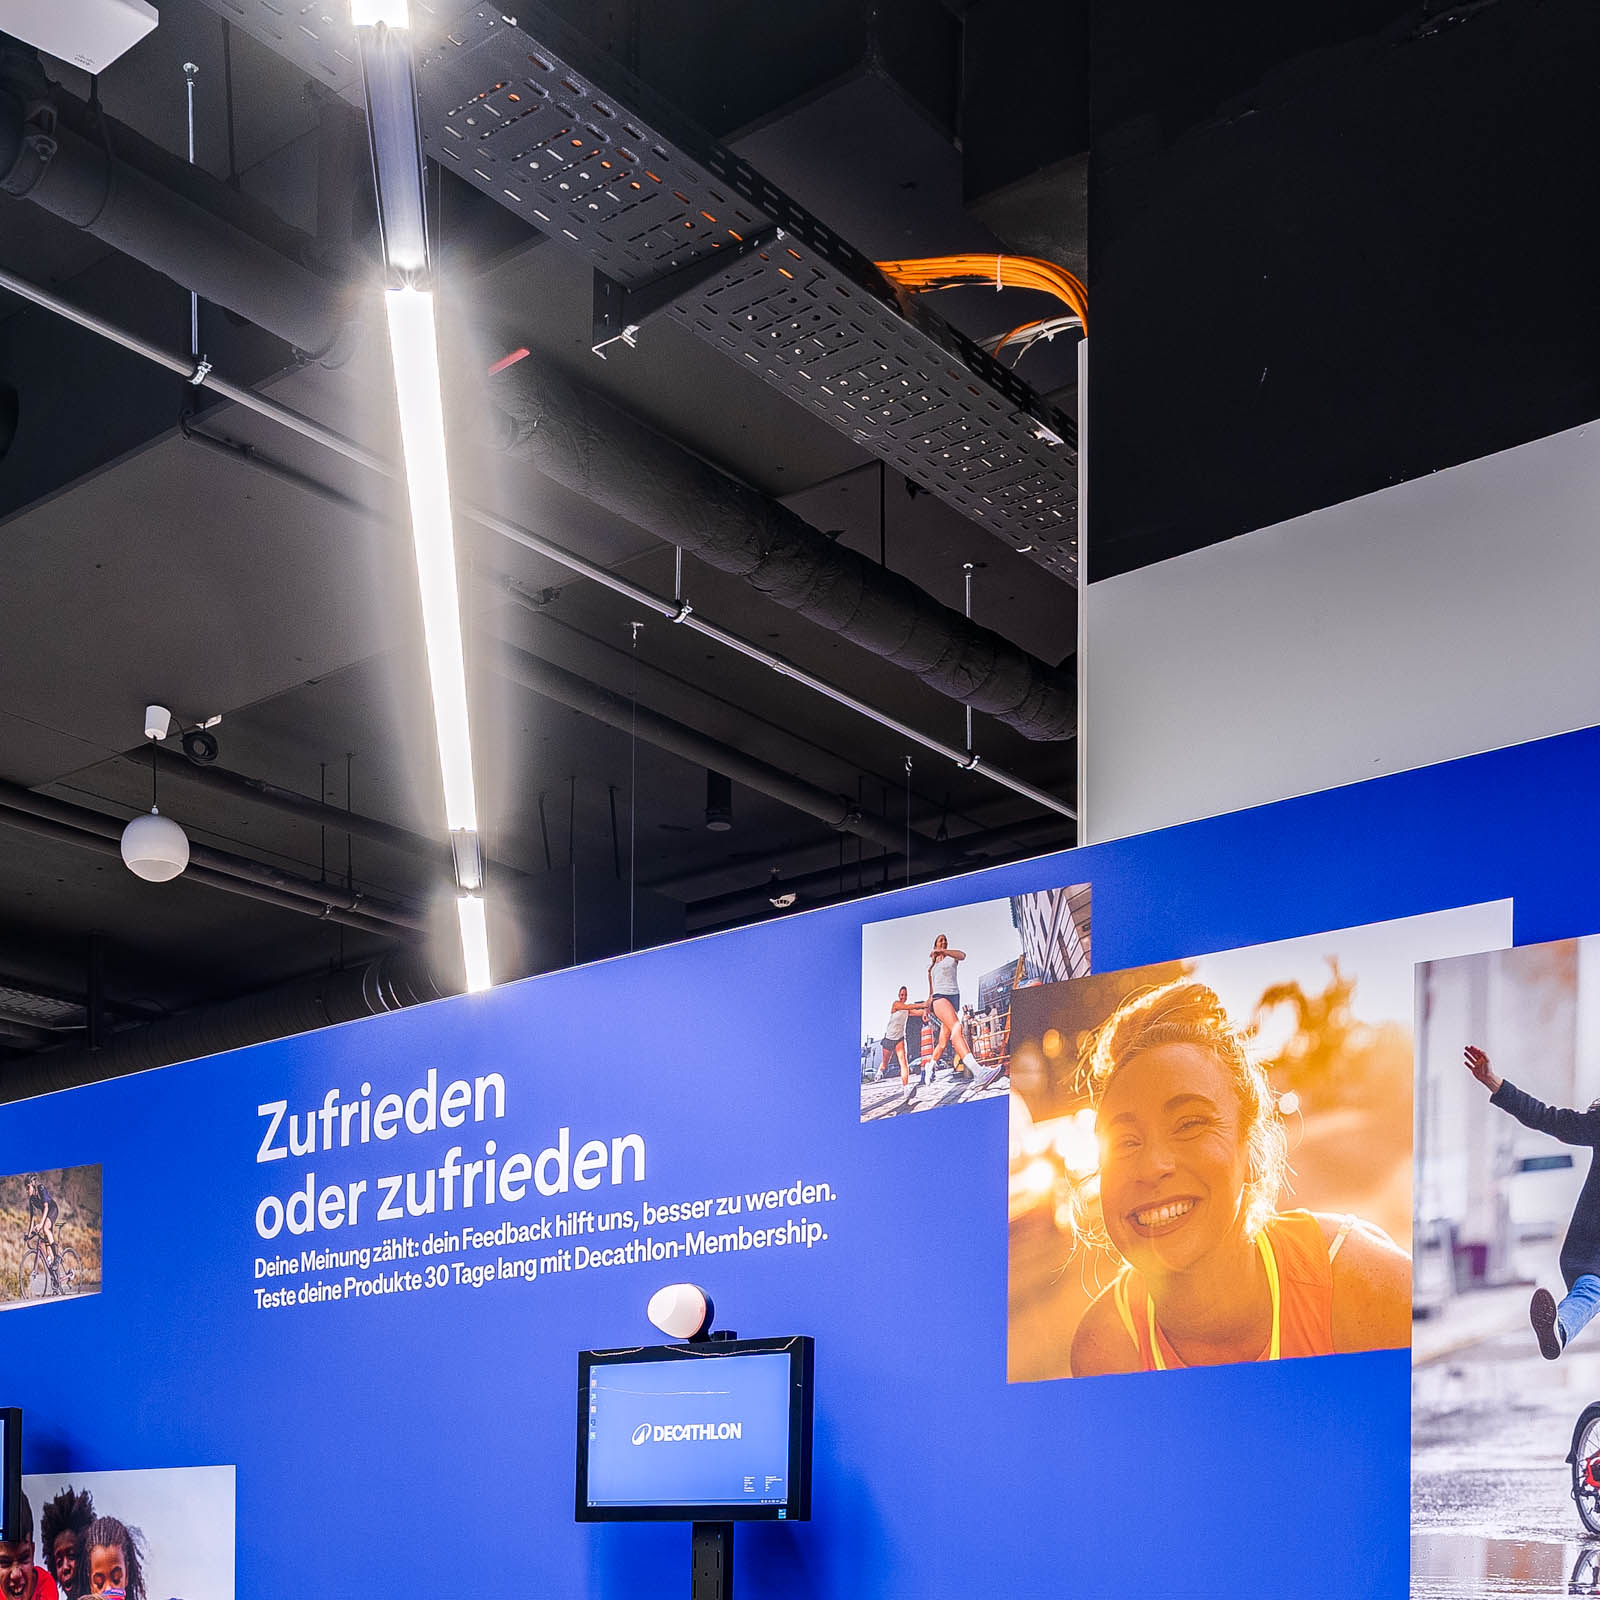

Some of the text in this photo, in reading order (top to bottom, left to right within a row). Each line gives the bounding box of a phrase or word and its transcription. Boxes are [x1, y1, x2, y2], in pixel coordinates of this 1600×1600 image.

[256, 1068, 506, 1164] Zufrieden
[254, 1180, 838, 1279] Deine Meinung zählt: dein Feedback hilft uns, besser zu werden.
[255, 1126, 646, 1240] oder zufrieden
[253, 1217, 829, 1310] Teste deine Produkte 30 Tage lang mit Decathlon-Membership.
[653, 1422, 742, 1442] DECATHLON
